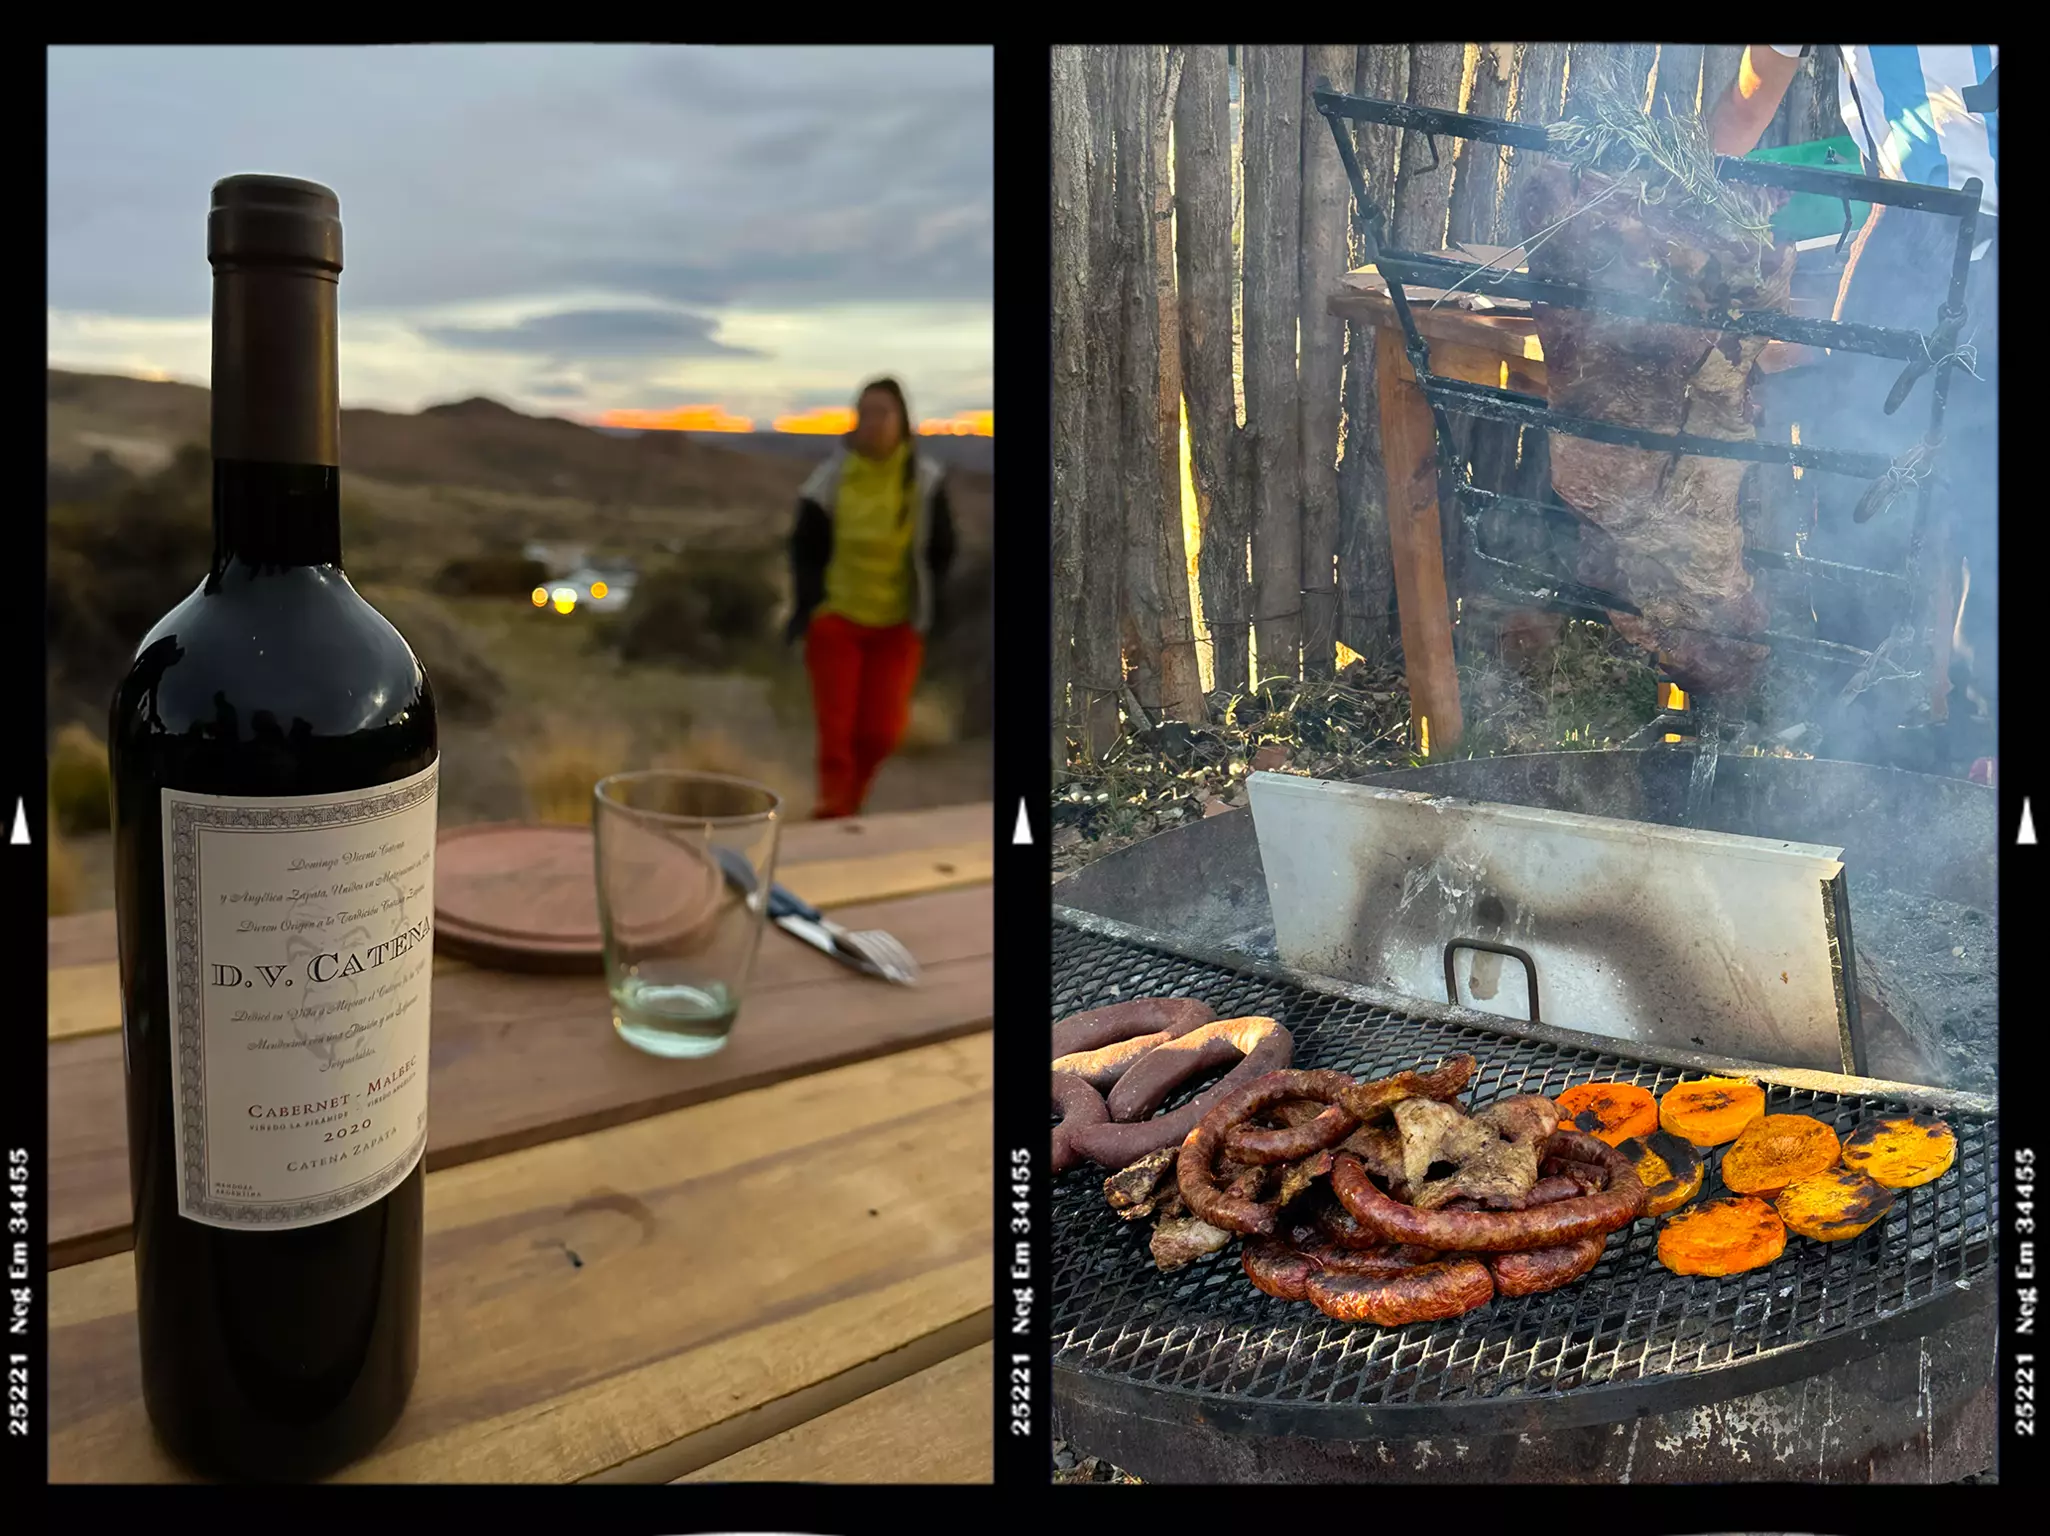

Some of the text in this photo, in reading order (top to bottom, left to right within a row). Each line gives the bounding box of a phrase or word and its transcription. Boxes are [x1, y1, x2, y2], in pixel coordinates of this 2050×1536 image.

[211, 963, 293, 988] D.V.
[306, 915, 430, 983] CATENA
[248, 1093, 351, 1119] CABERNET
[366, 1054, 417, 1097] MALBEC
[286, 1126, 397, 1172] CATENA ZAPATA
[323, 1118, 372, 1143] 2020
